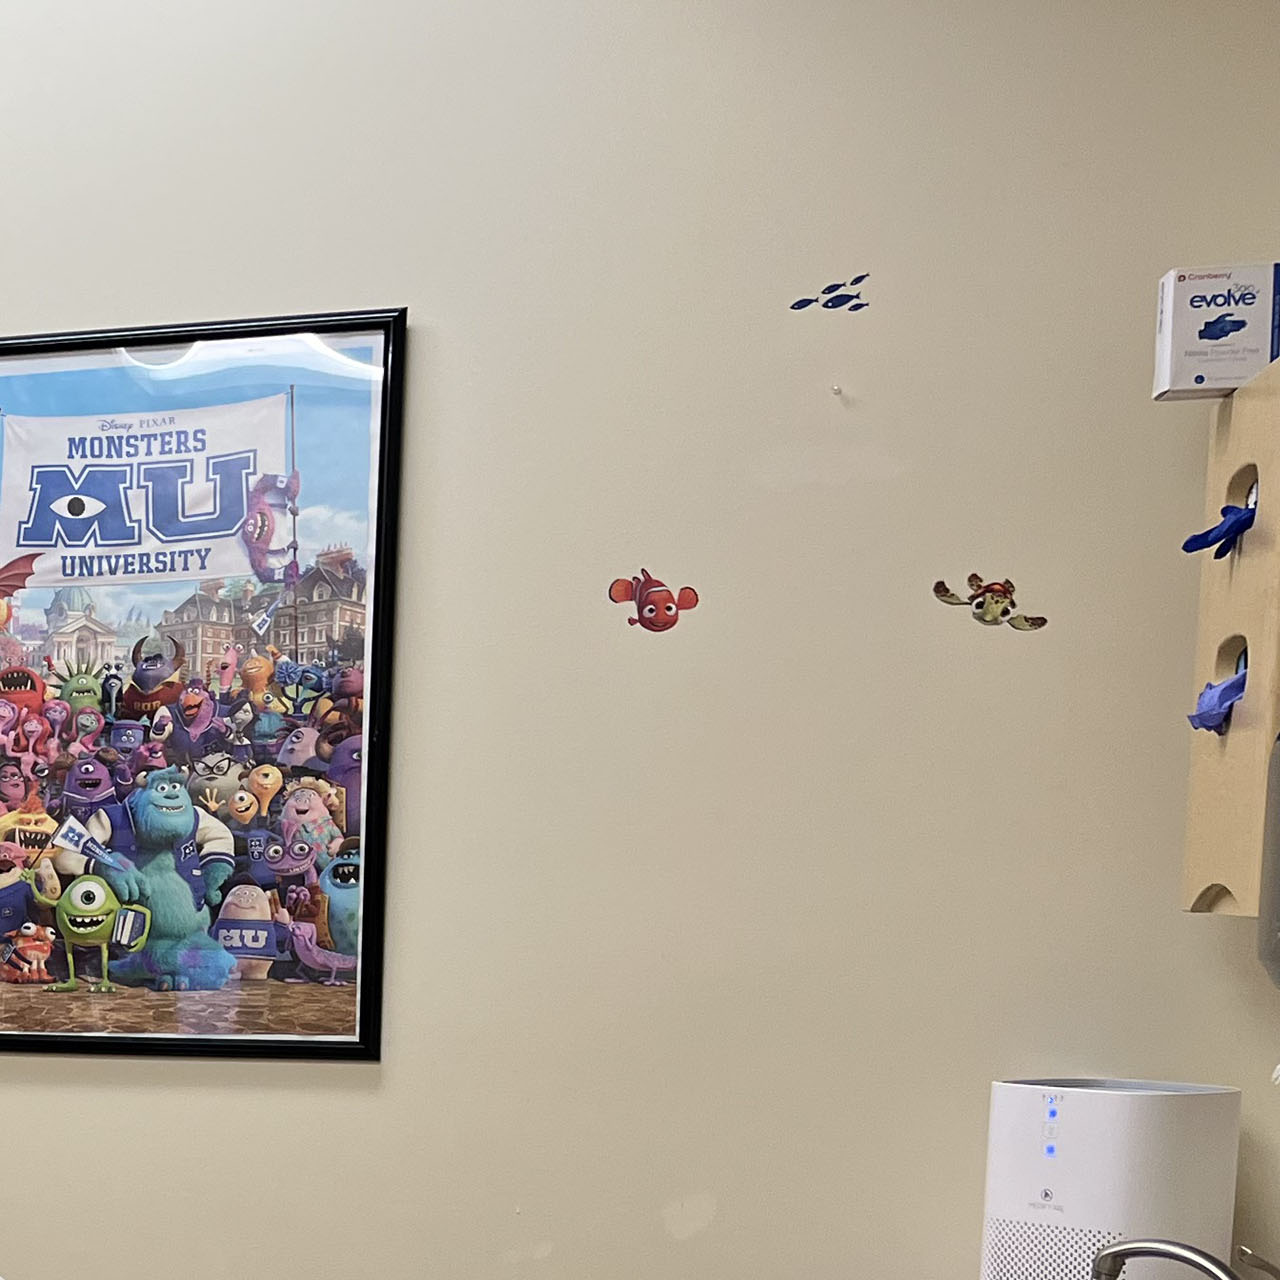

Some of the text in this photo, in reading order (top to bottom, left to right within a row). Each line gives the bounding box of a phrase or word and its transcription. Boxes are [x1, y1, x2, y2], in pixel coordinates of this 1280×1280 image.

[1189, 288, 1257, 309] evolve
[96, 416, 176, 432] Disney PIXAR
[67, 428, 207, 460] MONSTERS
[16, 448, 258, 549] MU
[60, 547, 212, 577] UNIVERSITY
[218, 929, 268, 949] MU
